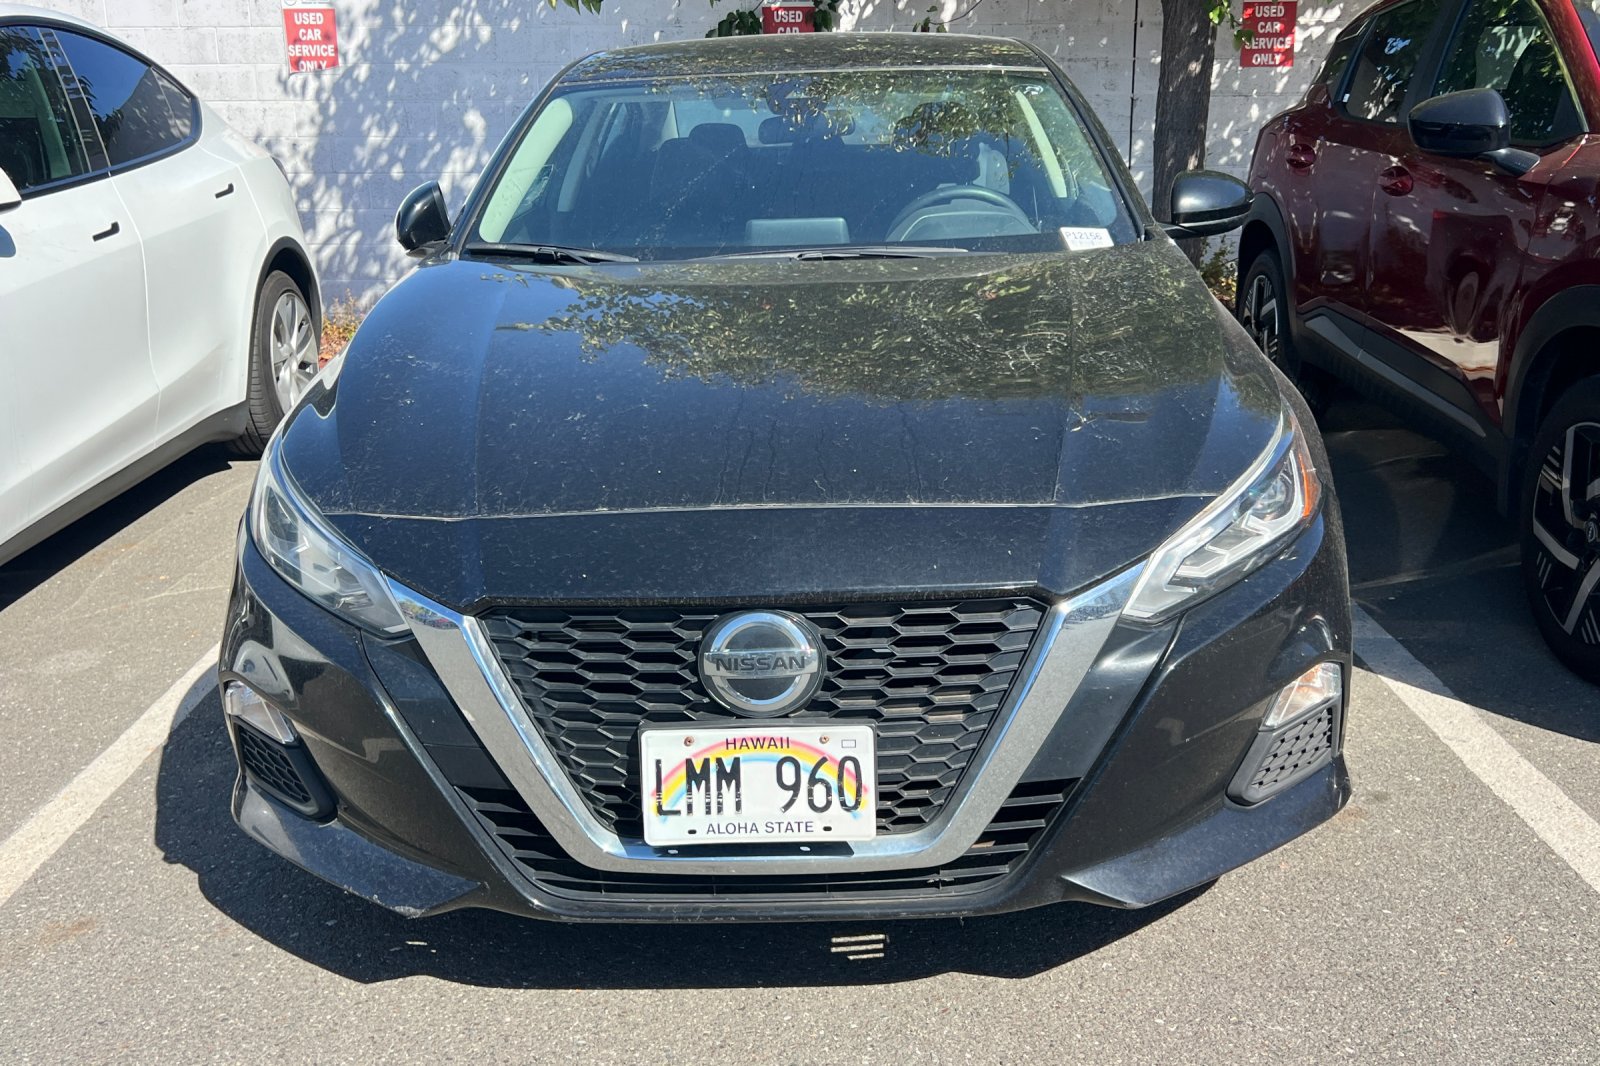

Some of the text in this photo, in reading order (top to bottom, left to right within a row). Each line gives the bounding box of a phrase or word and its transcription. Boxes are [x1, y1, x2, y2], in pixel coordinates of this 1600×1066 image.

[774, 10, 803, 23] USED
[1255, 5, 1285, 18] USED
[294, 12, 324, 25] USED
[1257, 21, 1281, 33] CAR
[298, 28, 322, 41] CAR
[288, 44, 335, 57] SERVICE
[298, 60, 327, 72] ONLY
[1252, 53, 1282, 66] ONLY
[715, 655, 806, 671] NISSAN
[725, 736, 791, 750] HAWAII
[655, 755, 863, 817] LMM 960
[706, 821, 815, 835] ALOHA STATE
